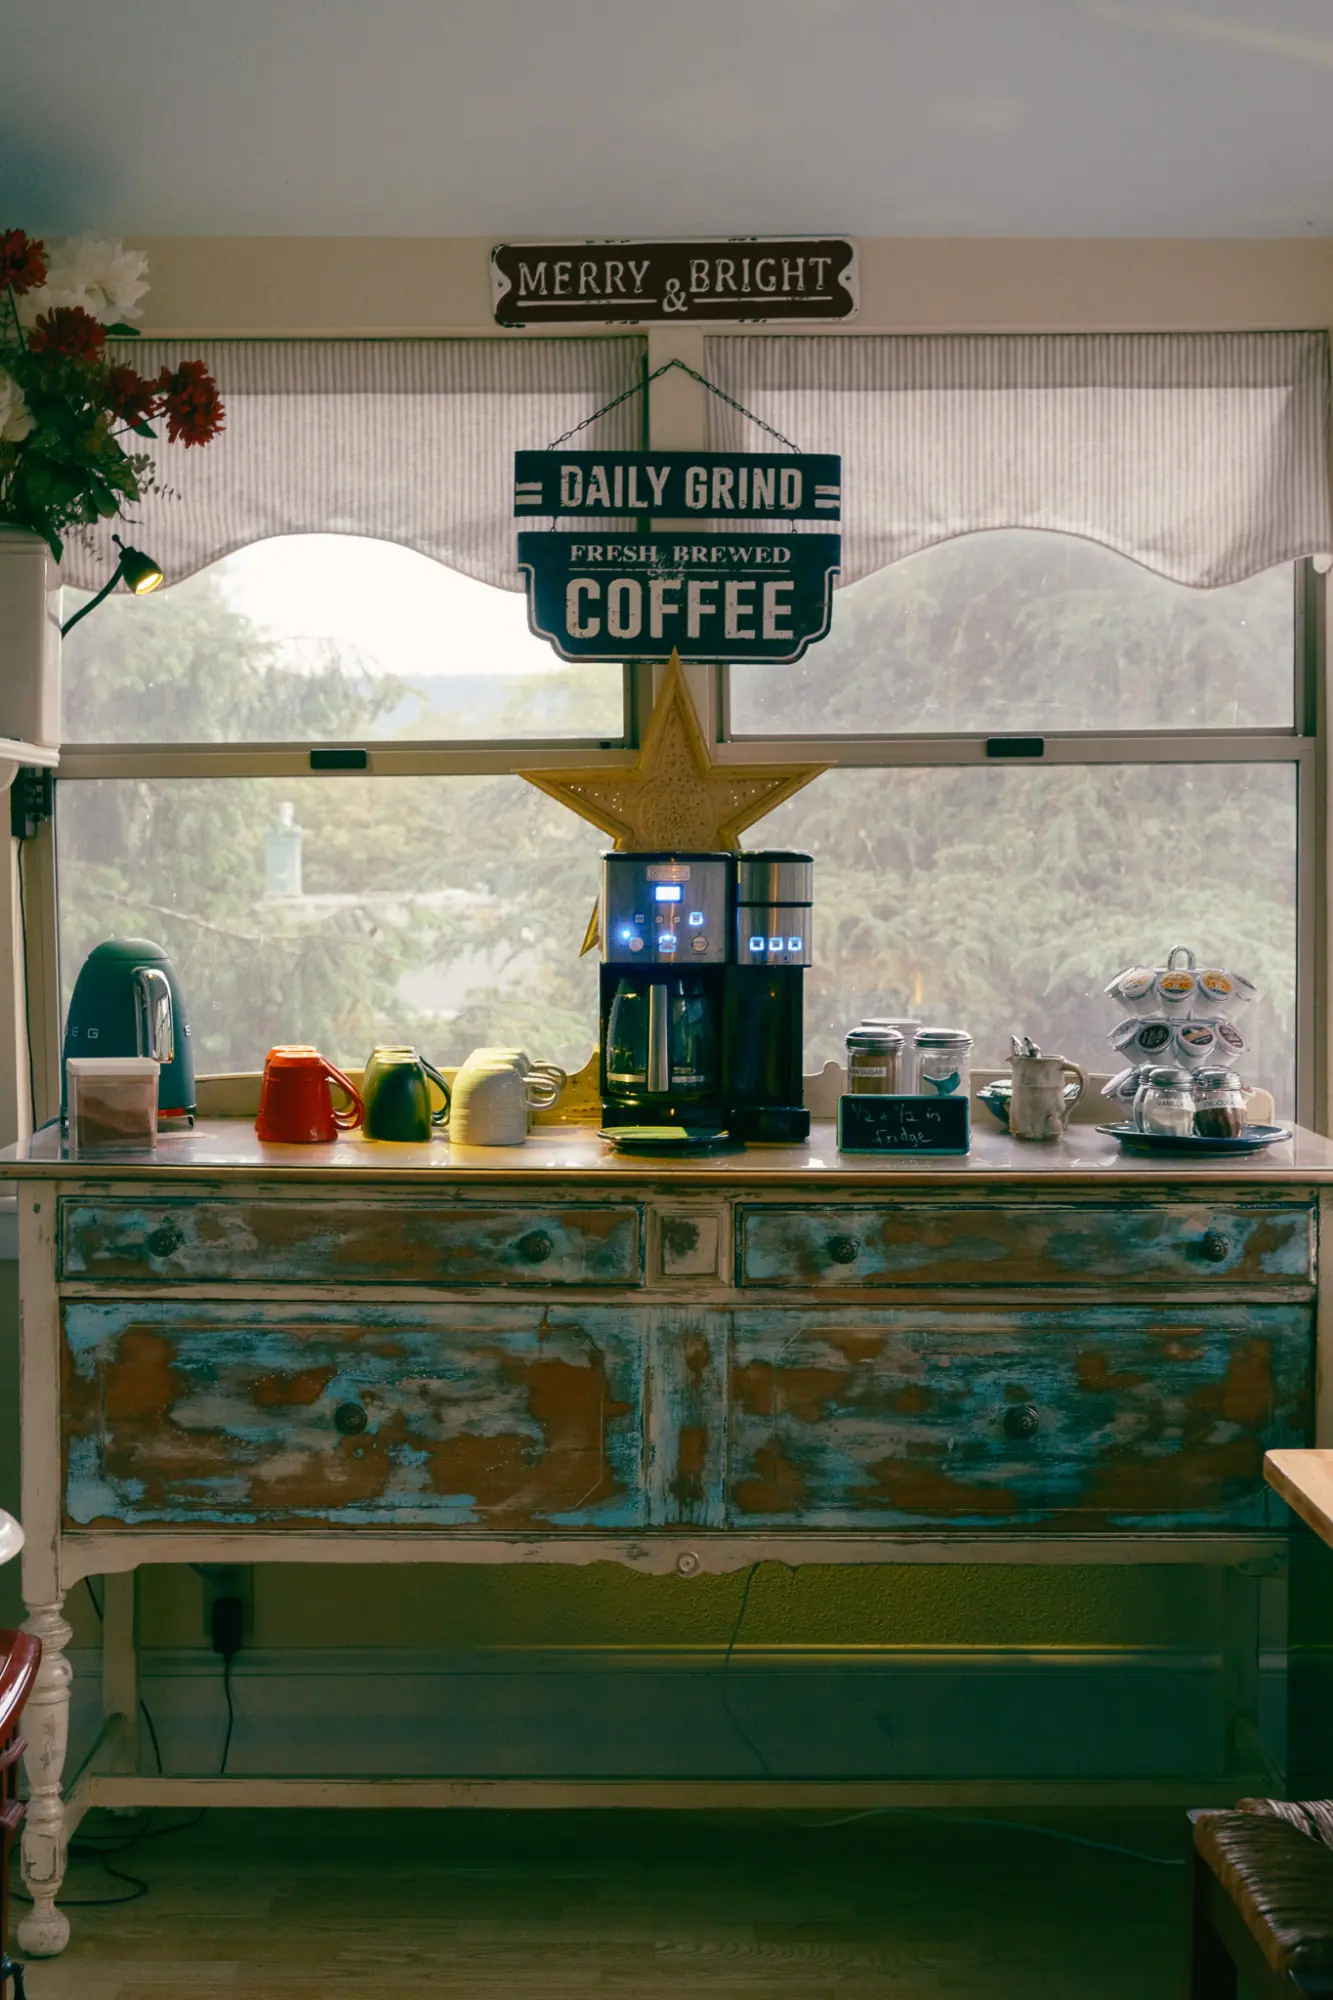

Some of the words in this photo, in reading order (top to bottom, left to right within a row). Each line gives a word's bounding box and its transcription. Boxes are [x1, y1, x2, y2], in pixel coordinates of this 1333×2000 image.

[518, 261, 650, 295] MERRY
[662, 278, 689, 312] &
[689, 258, 832, 292] BRIGHT
[560, 465, 671, 508] DAILY
[685, 466, 803, 510] GRIND
[569, 544, 658, 563] FRESH
[673, 546, 791, 564] BREWED
[565, 577, 795, 640] COFFEE
